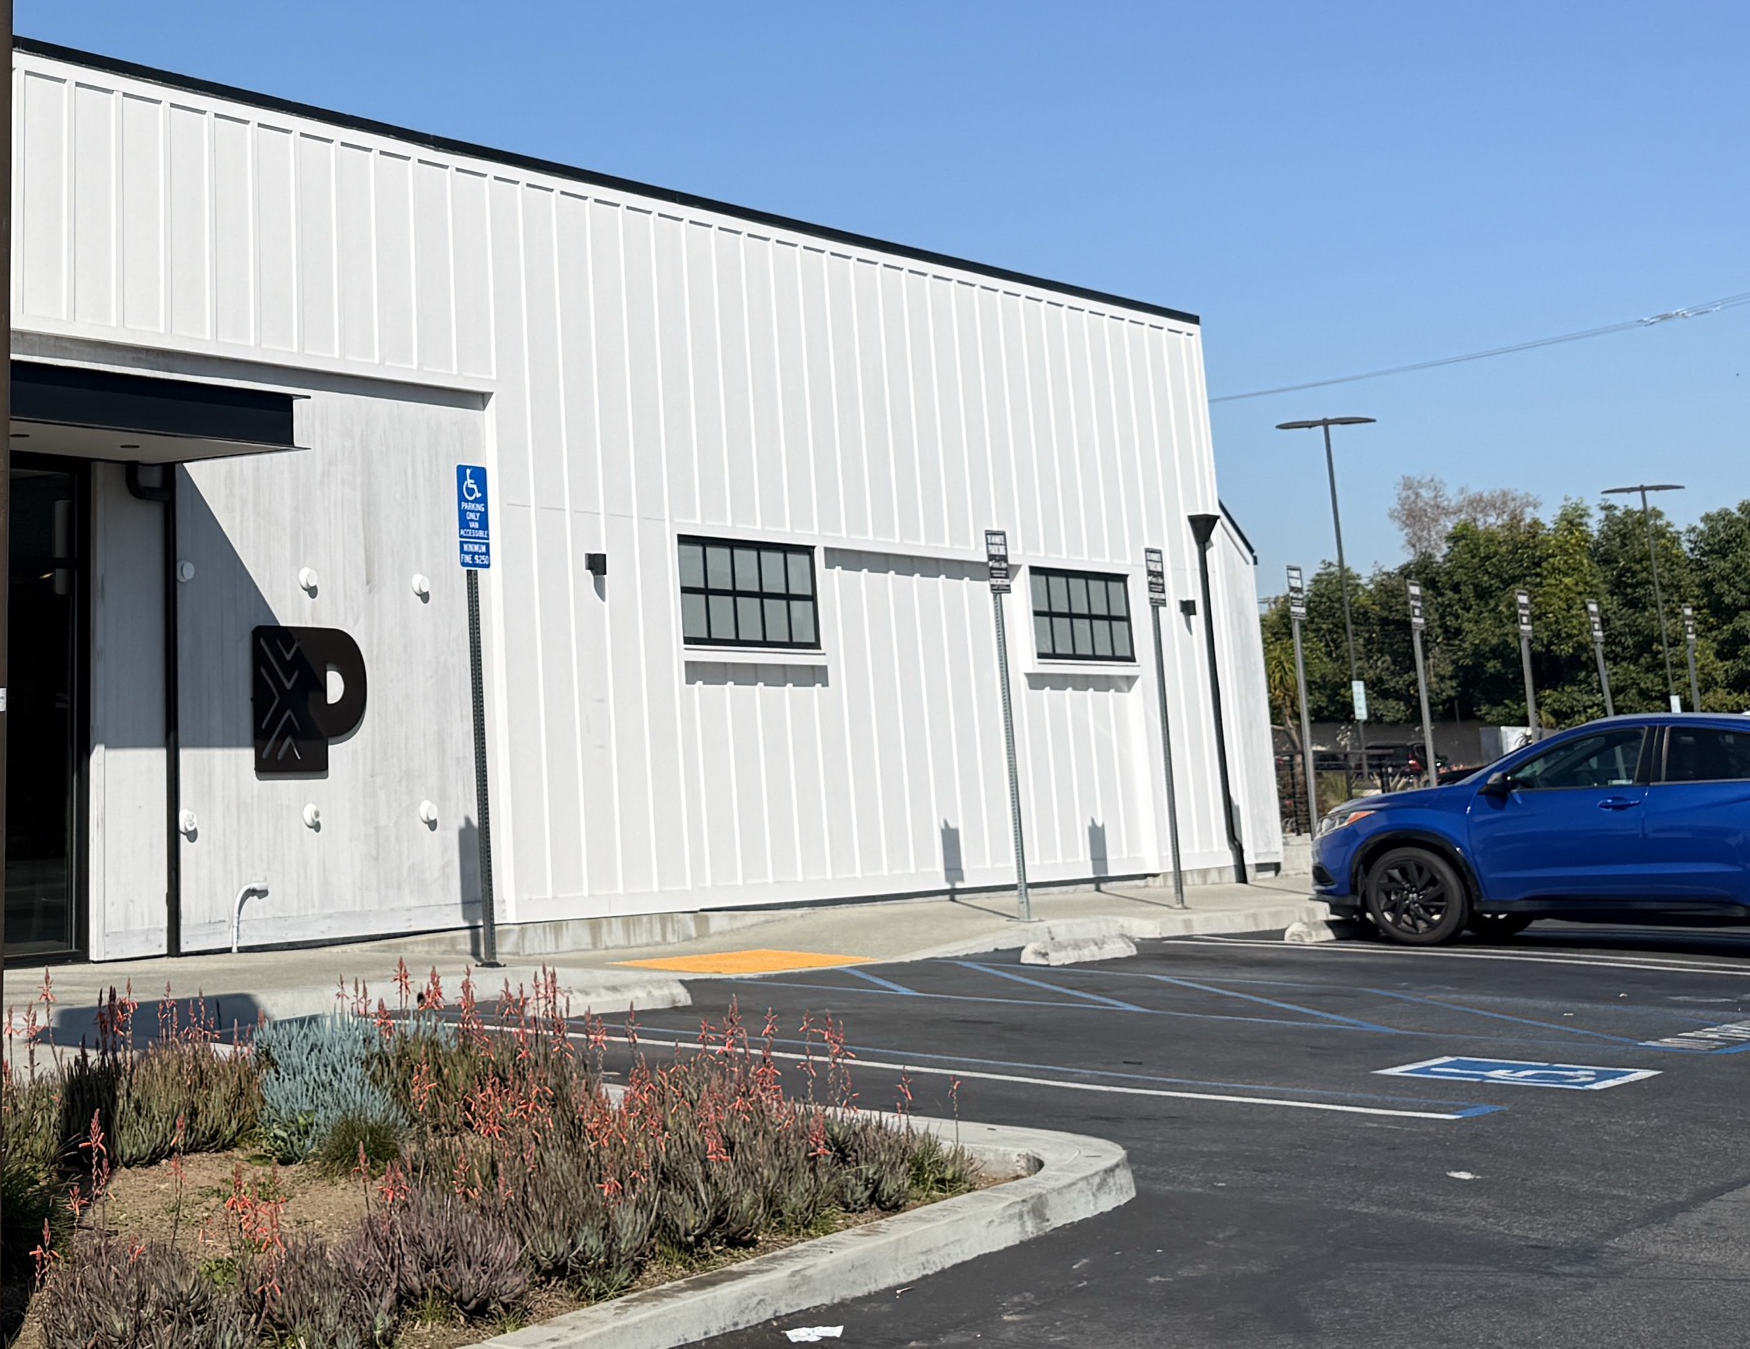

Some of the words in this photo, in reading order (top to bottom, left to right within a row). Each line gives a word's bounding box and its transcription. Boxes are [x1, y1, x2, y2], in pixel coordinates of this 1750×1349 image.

[461, 502, 485, 512] PARKING
[466, 512, 480, 520] ONLY
[461, 529, 488, 537] ACCESSIBLE
[463, 543, 486, 553] MINIMUM
[461, 554, 472, 563] FINE
[474, 555, 489, 564] $250
